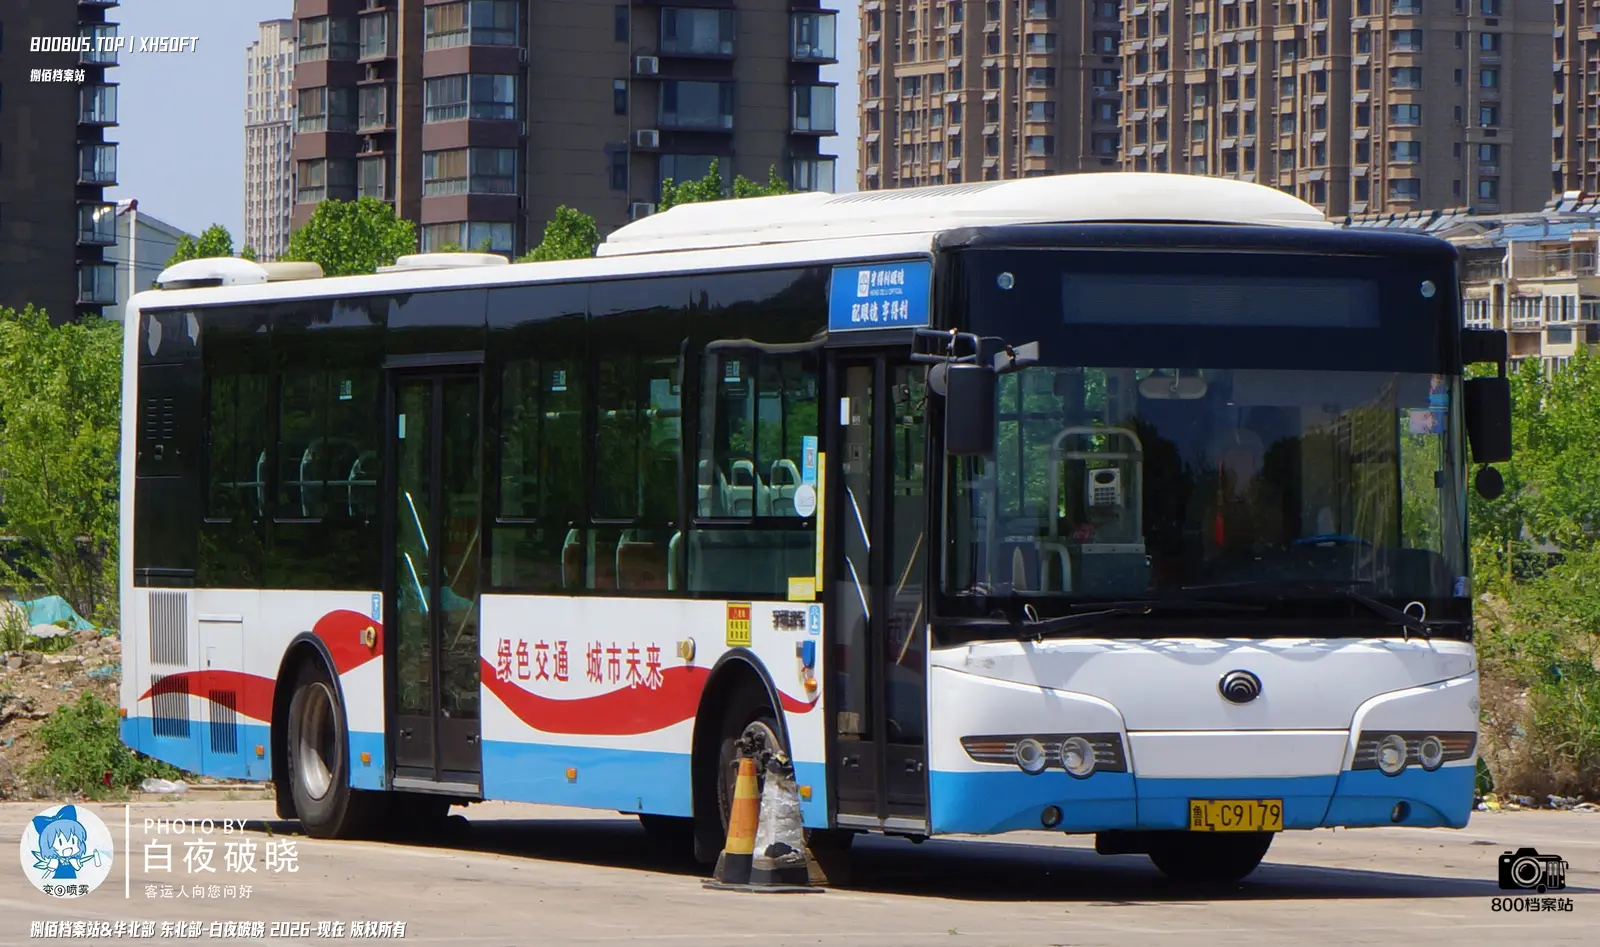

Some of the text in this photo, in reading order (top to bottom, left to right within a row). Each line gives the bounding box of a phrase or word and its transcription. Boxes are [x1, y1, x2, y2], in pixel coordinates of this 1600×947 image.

[496, 638, 664, 690] 绿色交通 城市未来
